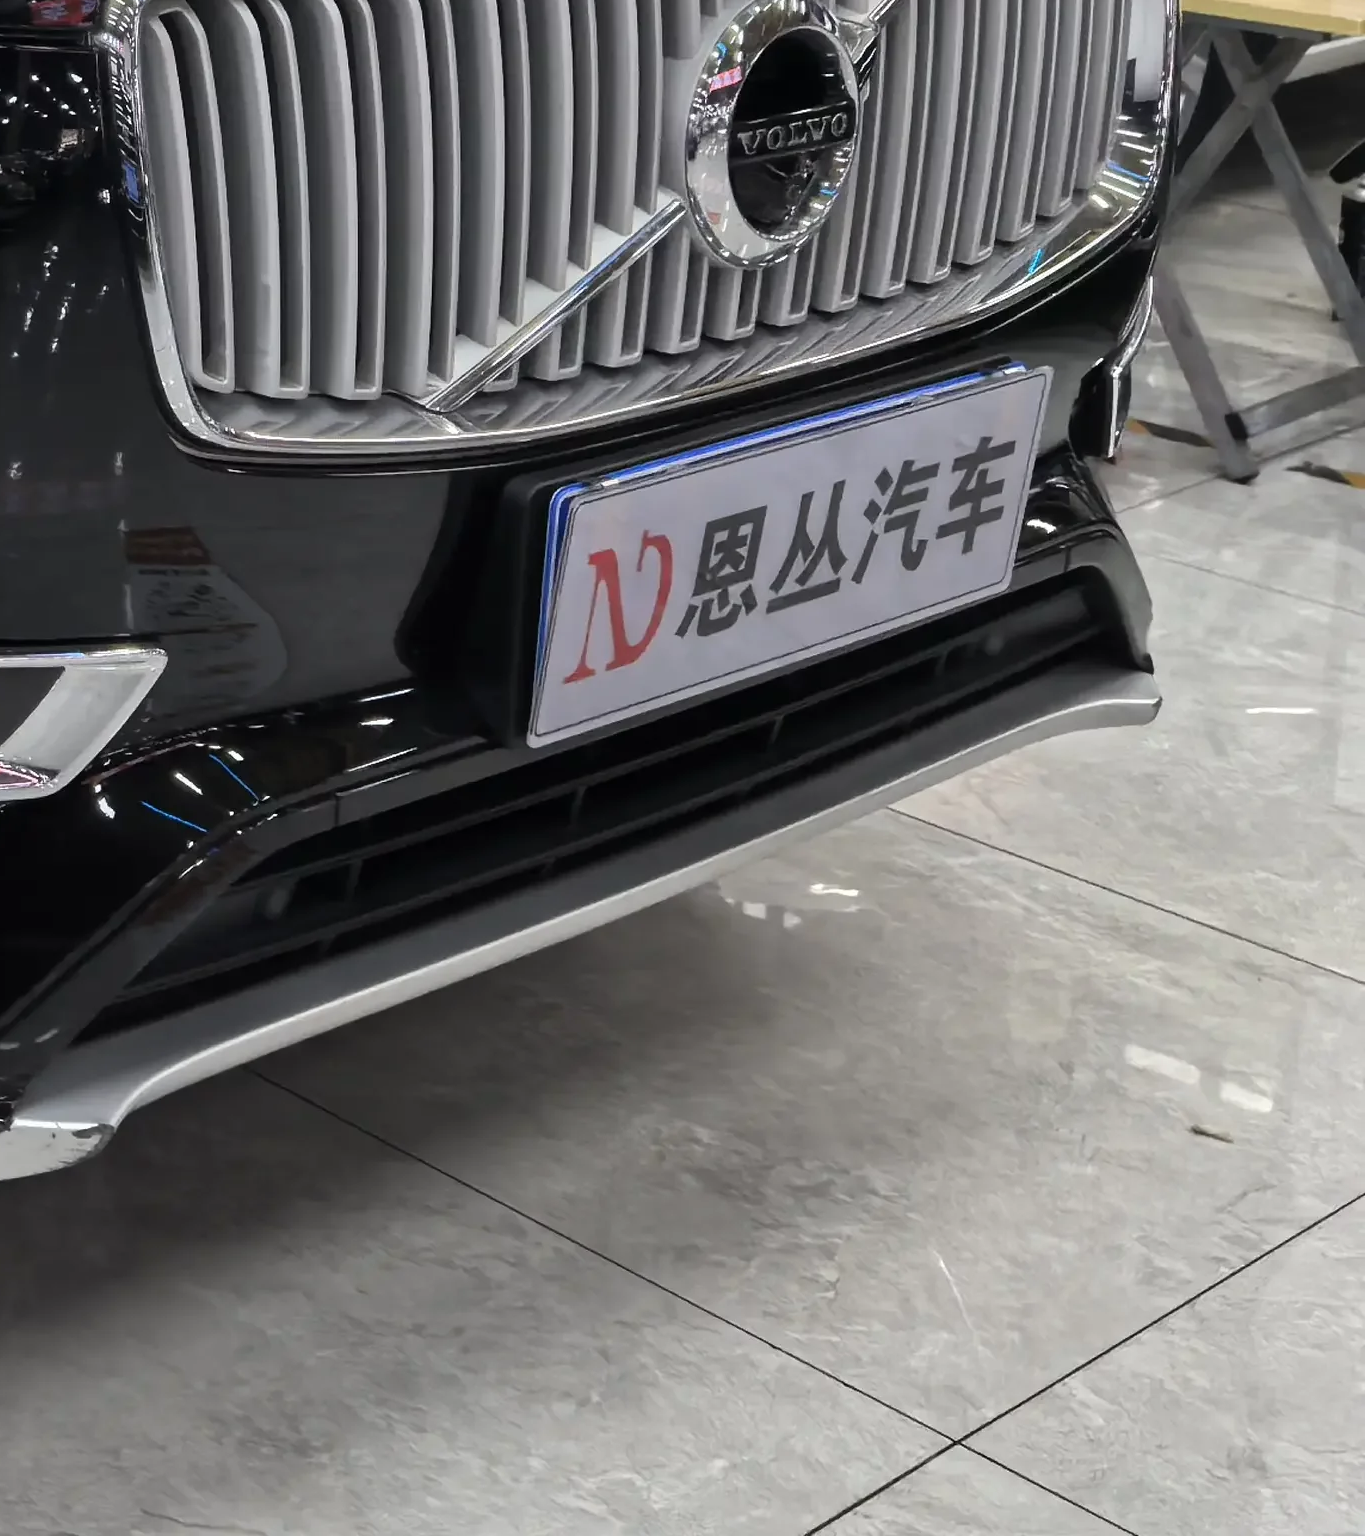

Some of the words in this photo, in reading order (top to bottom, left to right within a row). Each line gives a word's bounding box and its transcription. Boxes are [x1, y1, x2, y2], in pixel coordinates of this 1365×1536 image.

[737, 112, 849, 156] VOLVO
[674, 435, 1017, 640] 恩丛汽车
